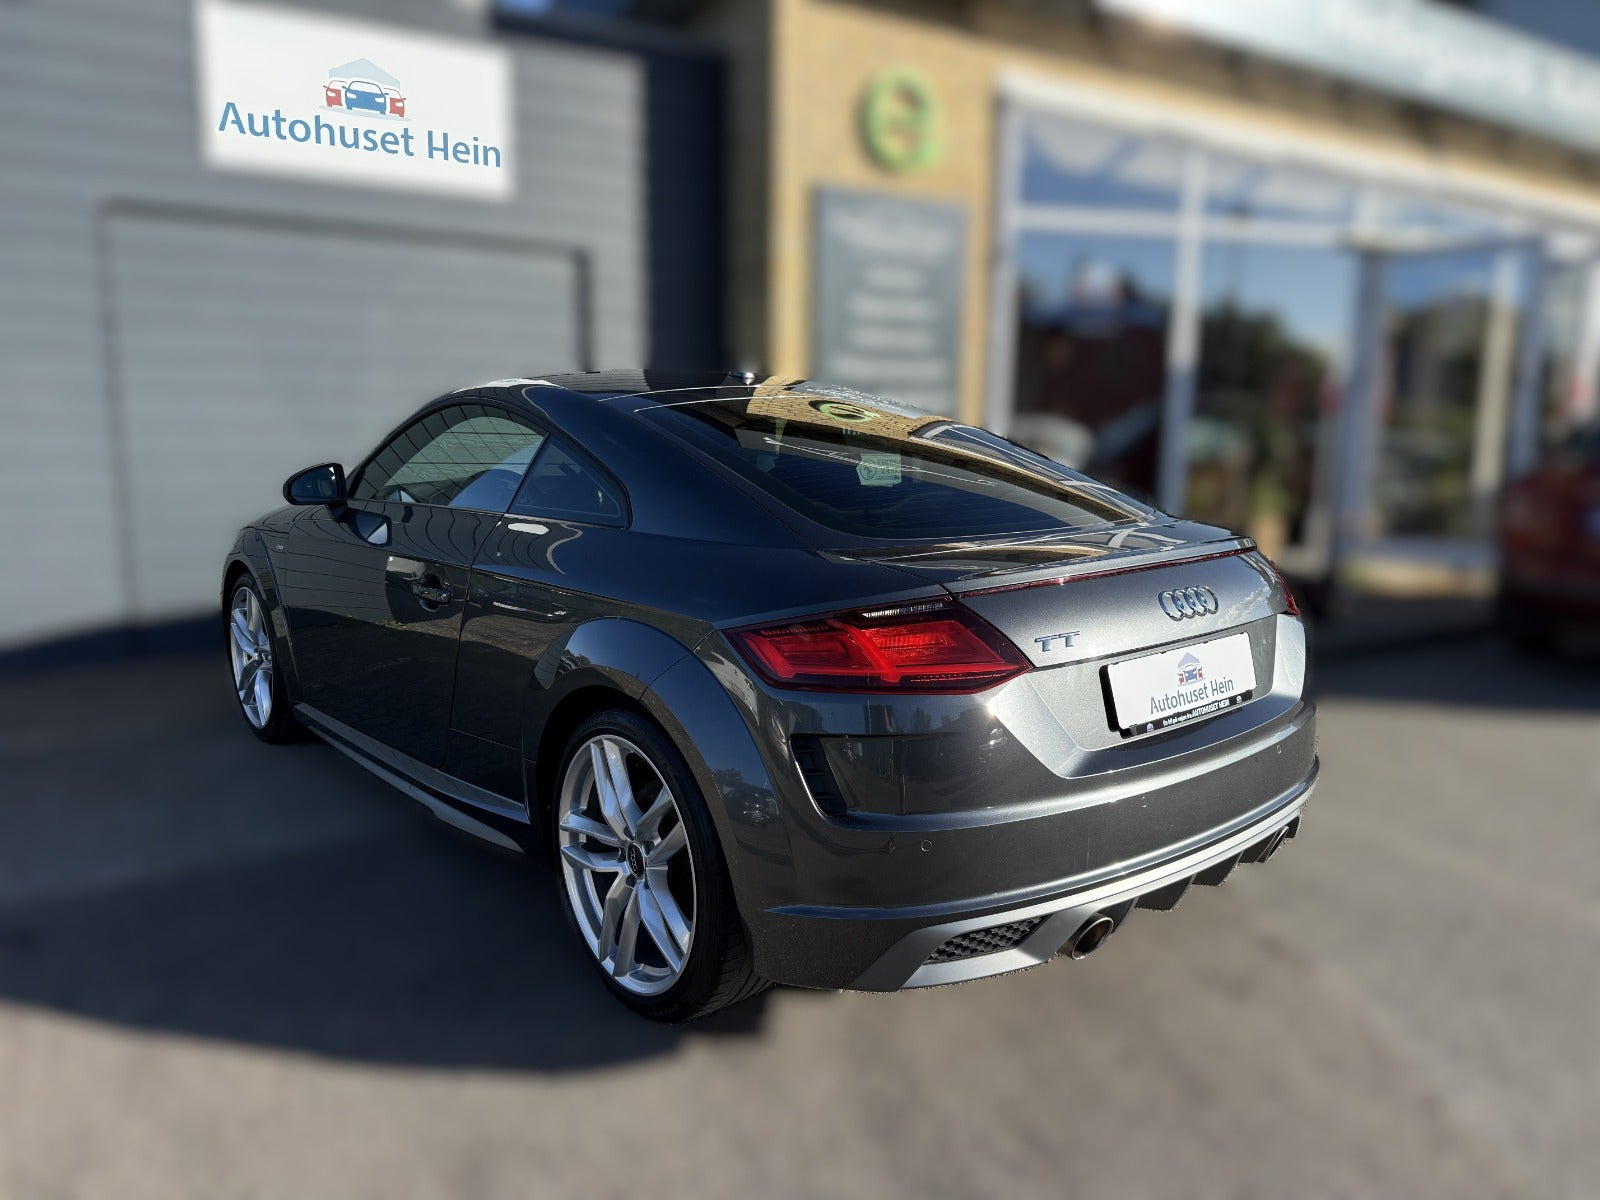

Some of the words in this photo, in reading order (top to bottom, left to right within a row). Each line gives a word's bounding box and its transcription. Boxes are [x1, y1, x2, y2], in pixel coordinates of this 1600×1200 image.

[218, 101, 414, 157] Autohuset
[427, 130, 501, 168] Hein
[1035, 630, 1081, 652] TT
[1150, 682, 1209, 715] Autohuset
[1210, 676, 1234, 697] Hein
